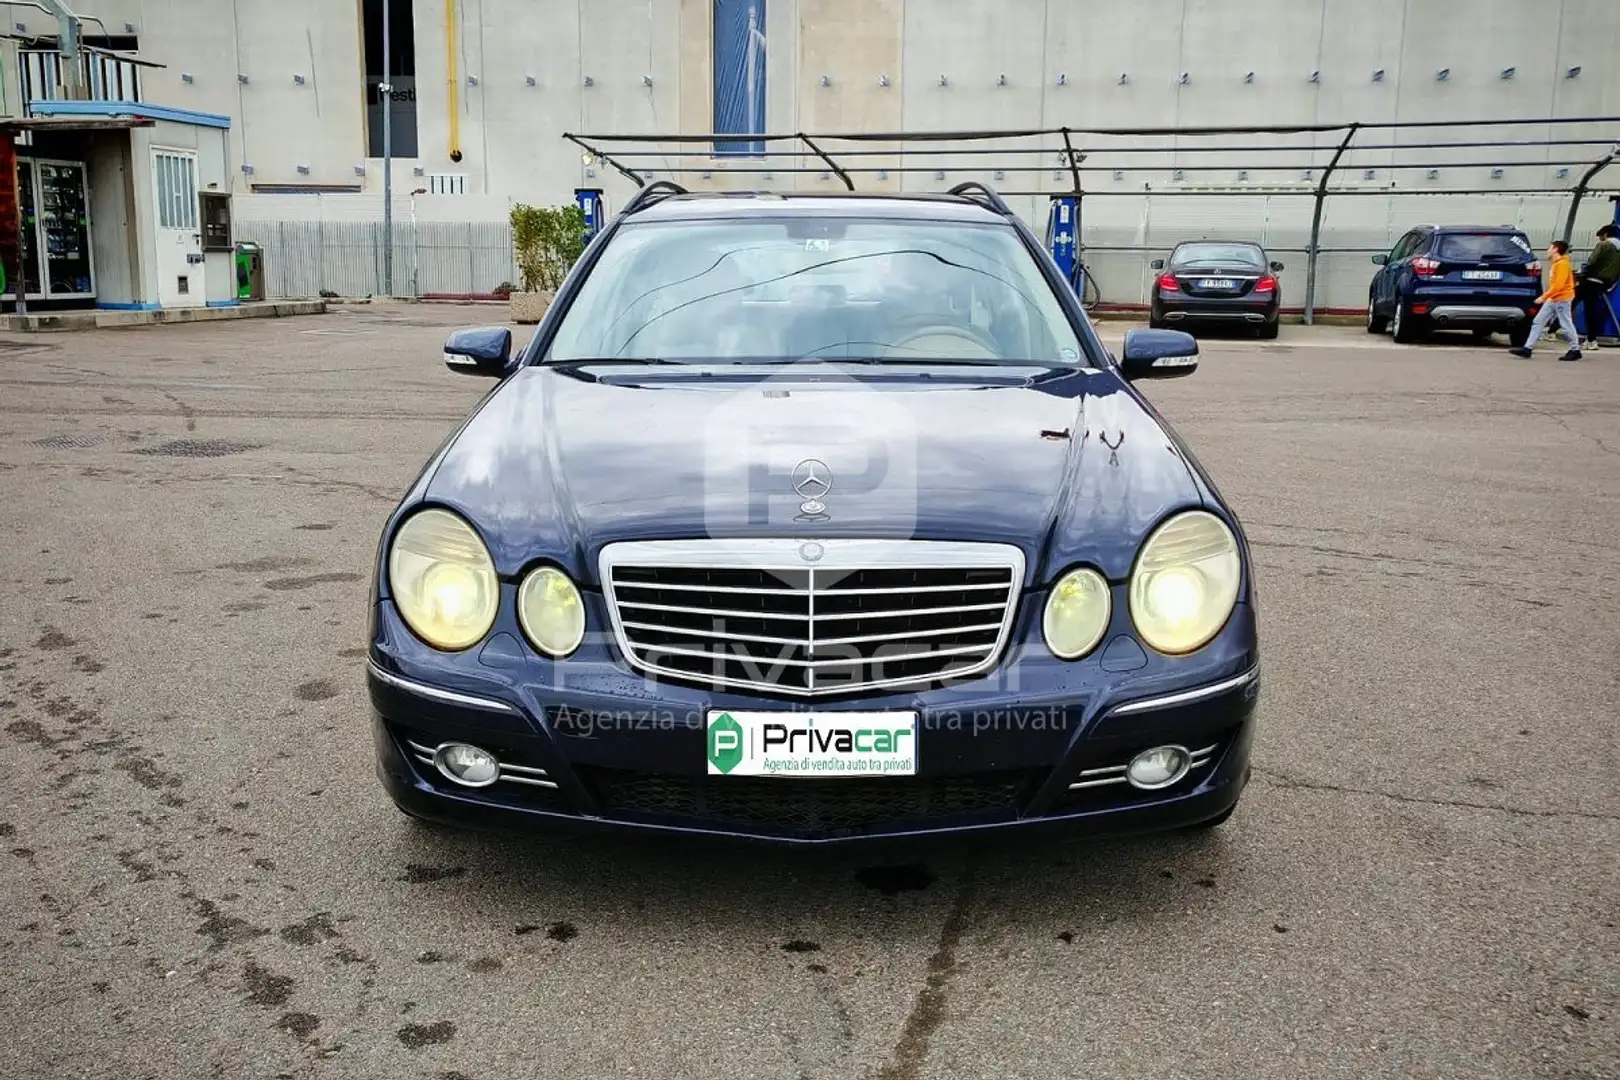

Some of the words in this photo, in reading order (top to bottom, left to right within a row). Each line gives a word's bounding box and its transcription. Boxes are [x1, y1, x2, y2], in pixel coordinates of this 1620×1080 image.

[763, 718, 911, 753] Privacar
[763, 757, 799, 773] Agenzia
[801, 756, 810, 771] di
[812, 757, 844, 771] vendita
[846, 759, 867, 771] auto
[869, 758, 881, 771] tra
[883, 757, 912, 773] privati
